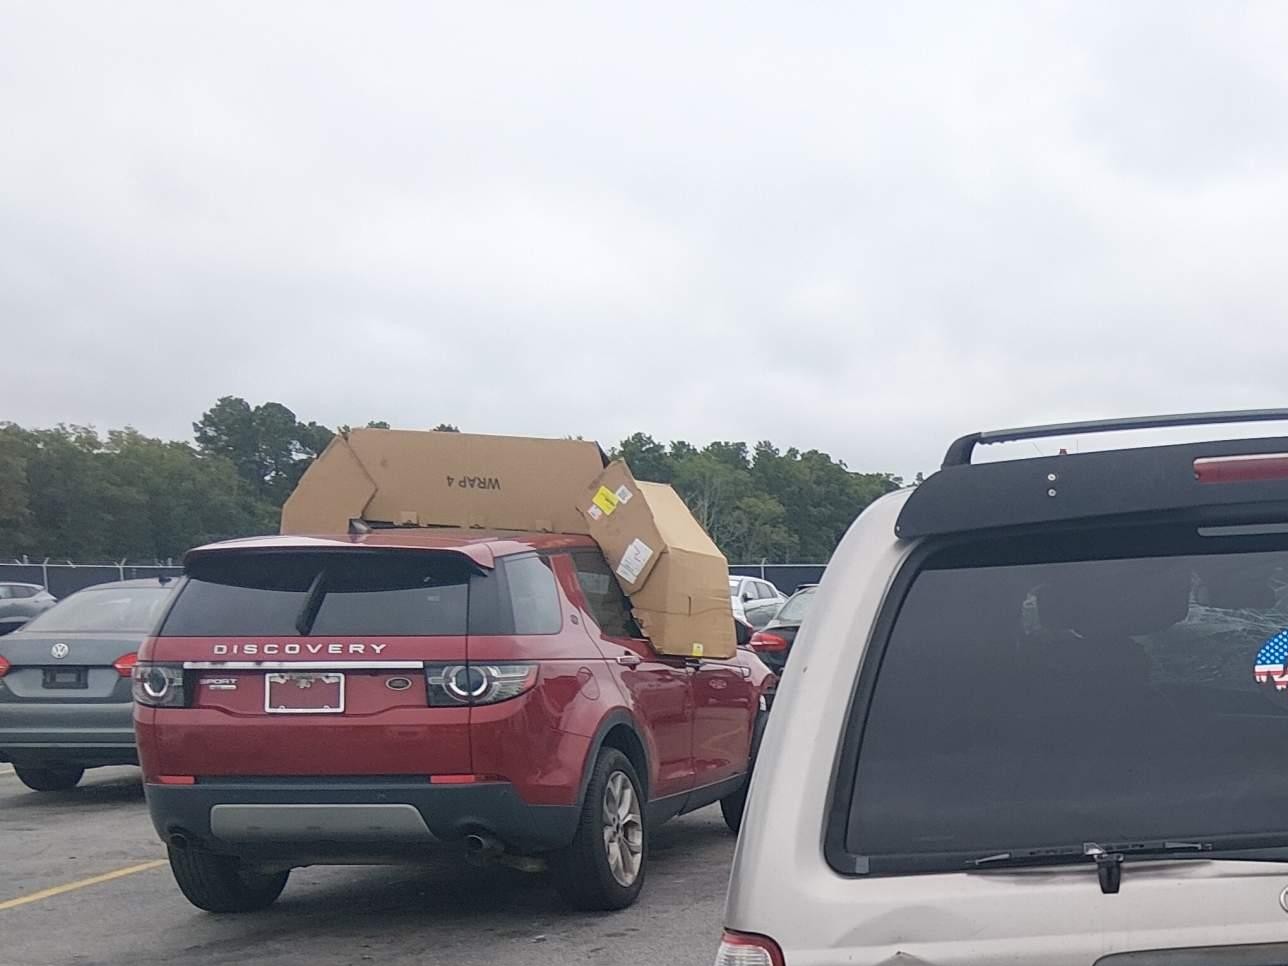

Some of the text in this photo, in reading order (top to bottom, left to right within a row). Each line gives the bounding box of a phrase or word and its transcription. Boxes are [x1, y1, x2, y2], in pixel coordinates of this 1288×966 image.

[446, 475, 502, 491] WRAP 4
[213, 643, 387, 655] DISCOVERY
